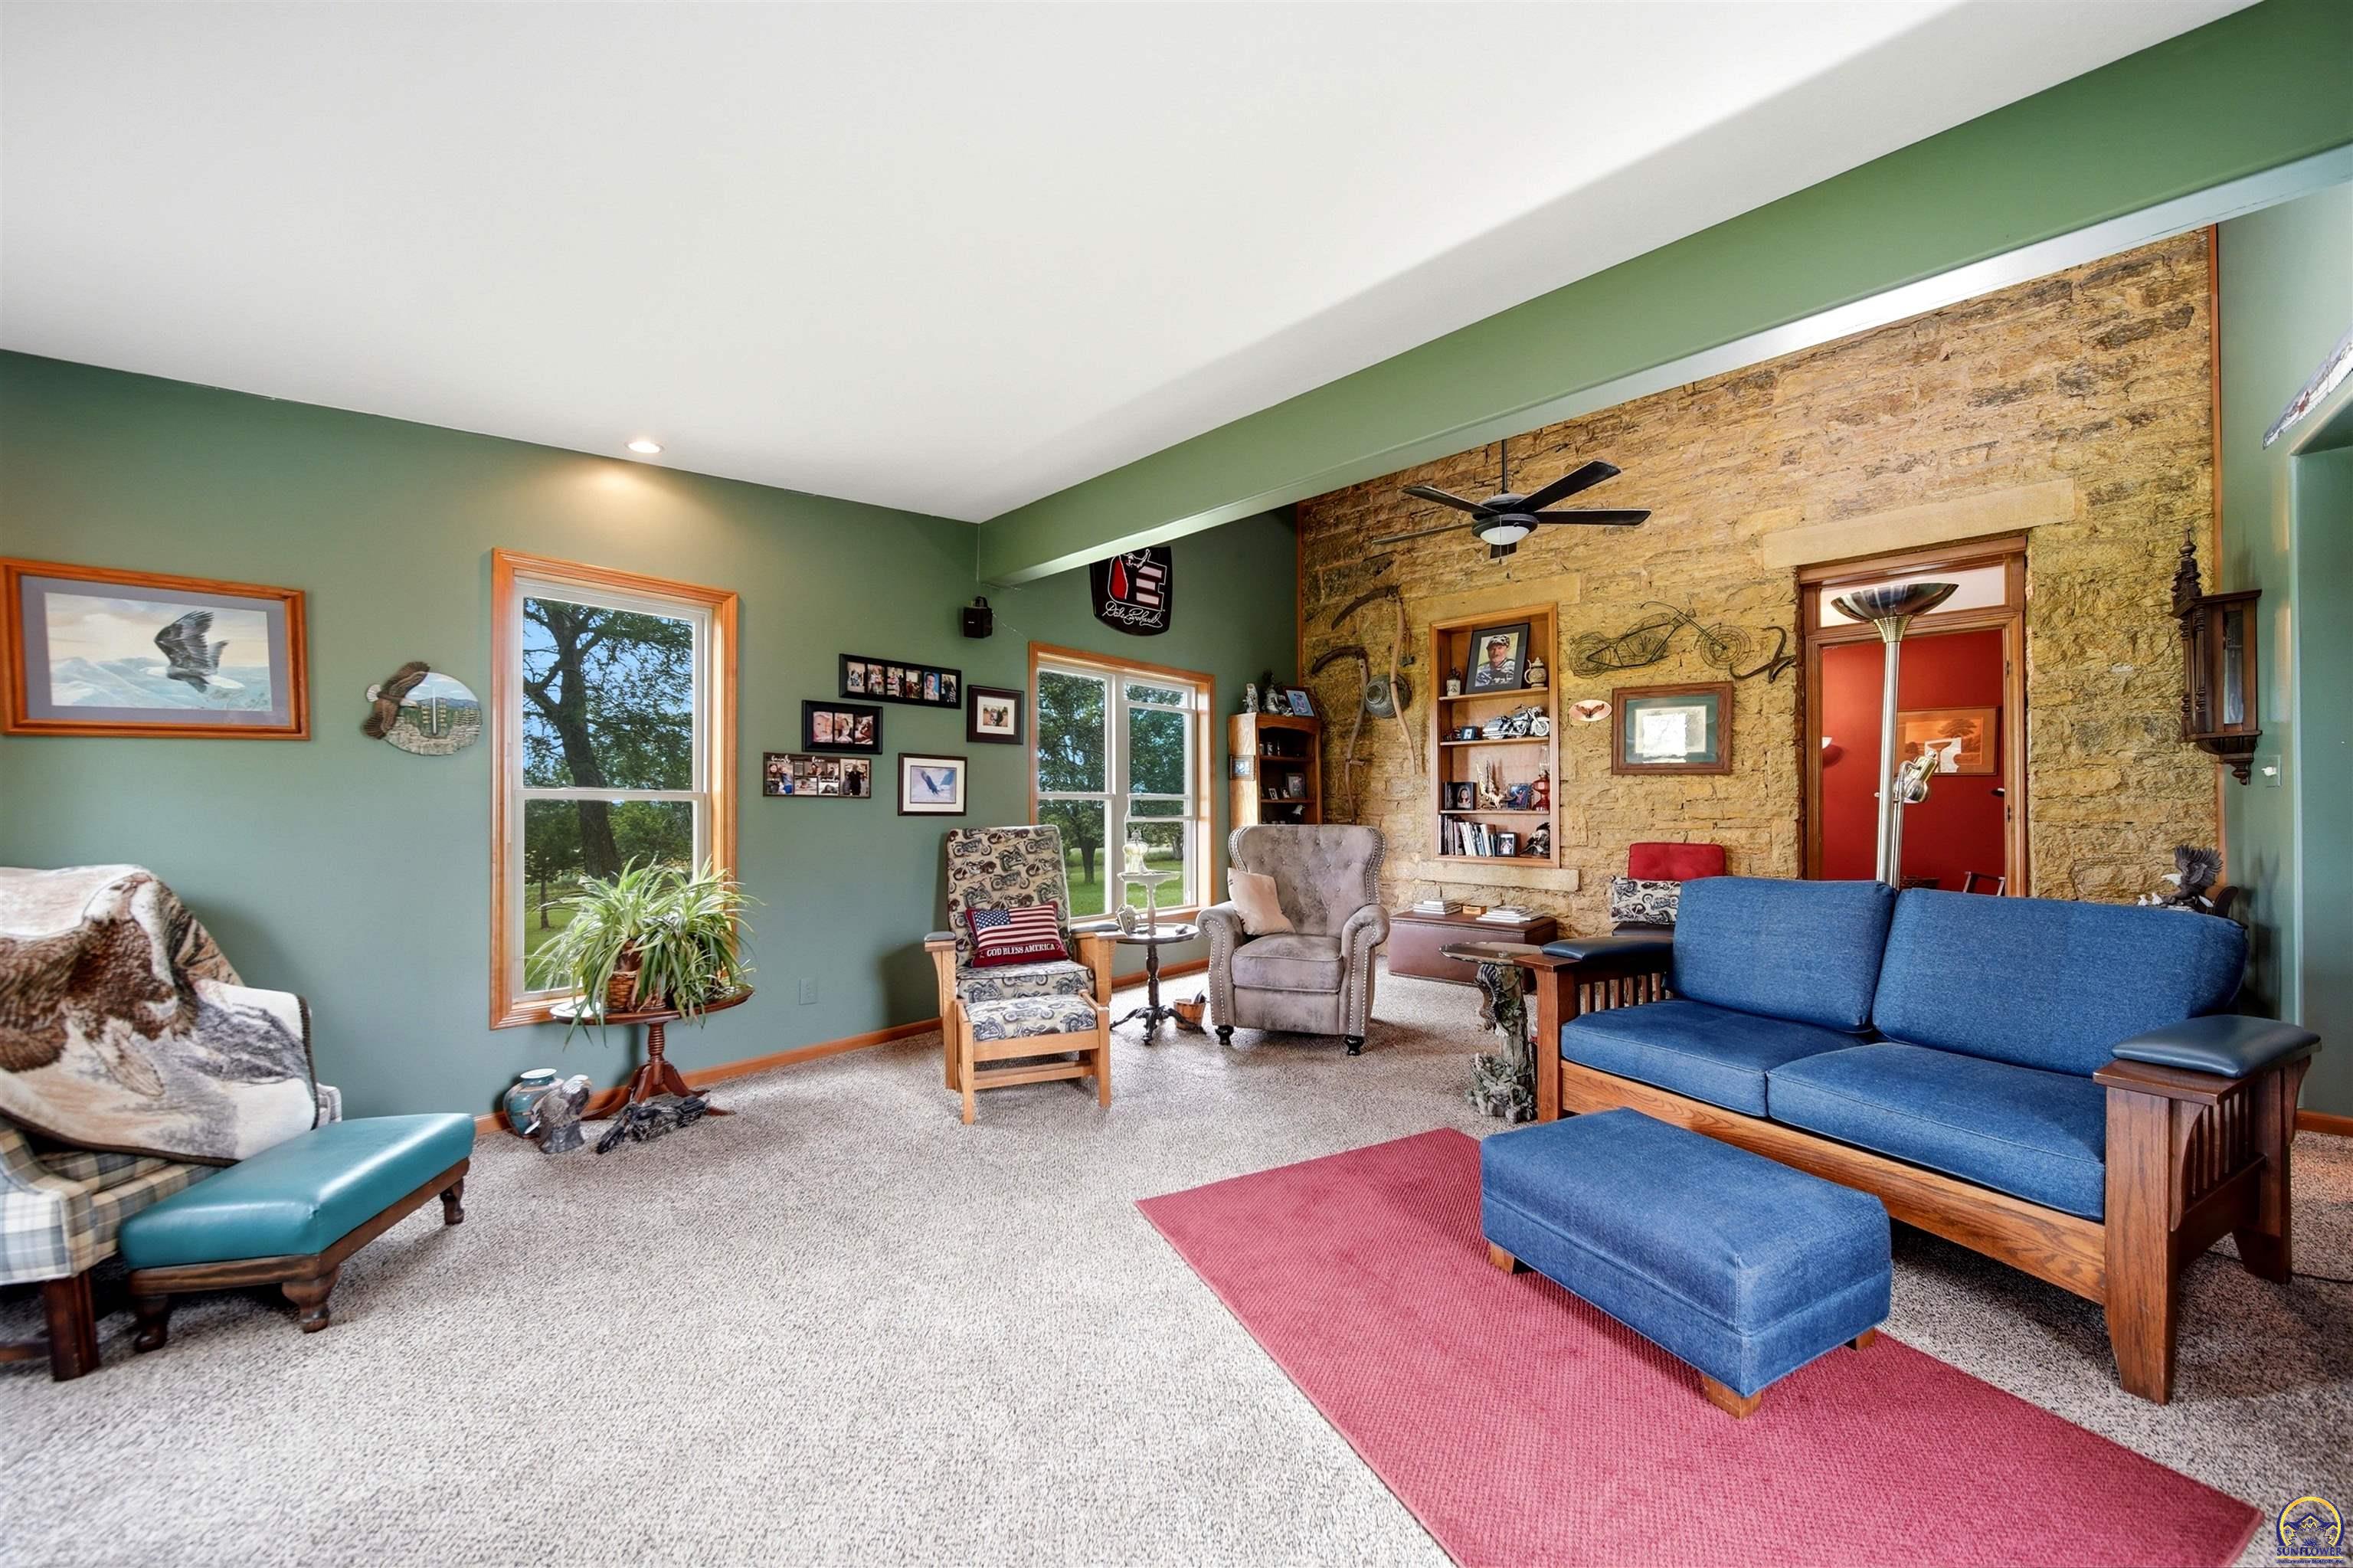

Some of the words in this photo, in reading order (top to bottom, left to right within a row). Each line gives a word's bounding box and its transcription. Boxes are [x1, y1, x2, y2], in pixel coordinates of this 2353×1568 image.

[987, 948, 1002, 957] GOD
[1003, 946, 1024, 955] BLESS
[1024, 943, 1055, 954] AMERICA
